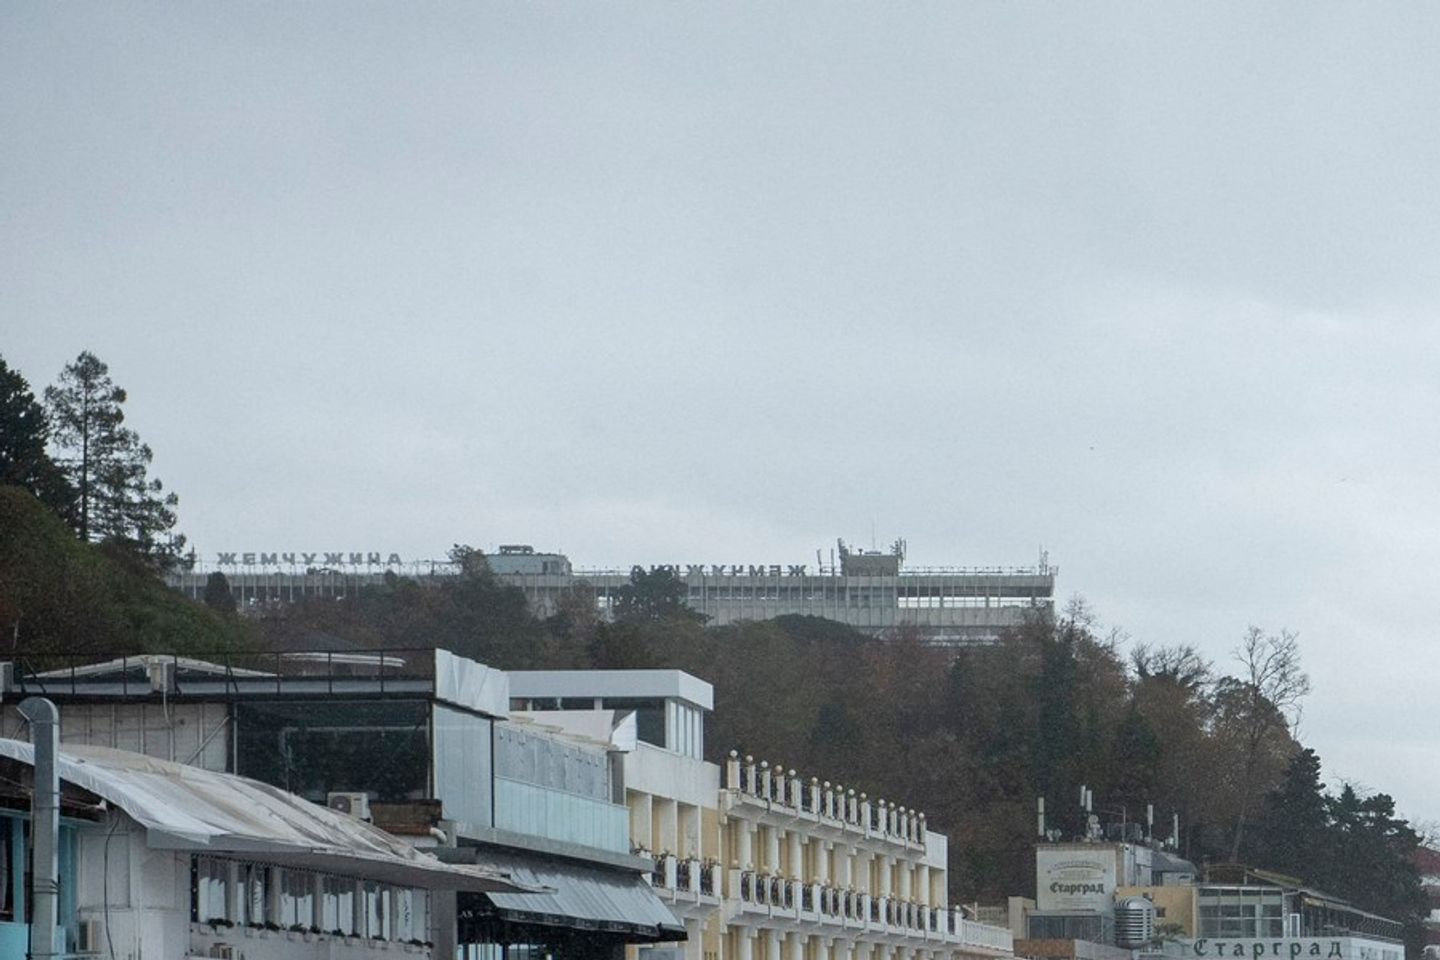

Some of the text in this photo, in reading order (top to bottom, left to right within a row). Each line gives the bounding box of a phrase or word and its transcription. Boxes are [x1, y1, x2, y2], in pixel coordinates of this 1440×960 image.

[217, 552, 402, 566] ЖЕМЧУЖИНА
[1050, 882, 1105, 896] Старград
[1194, 939, 1342, 960] Старград
